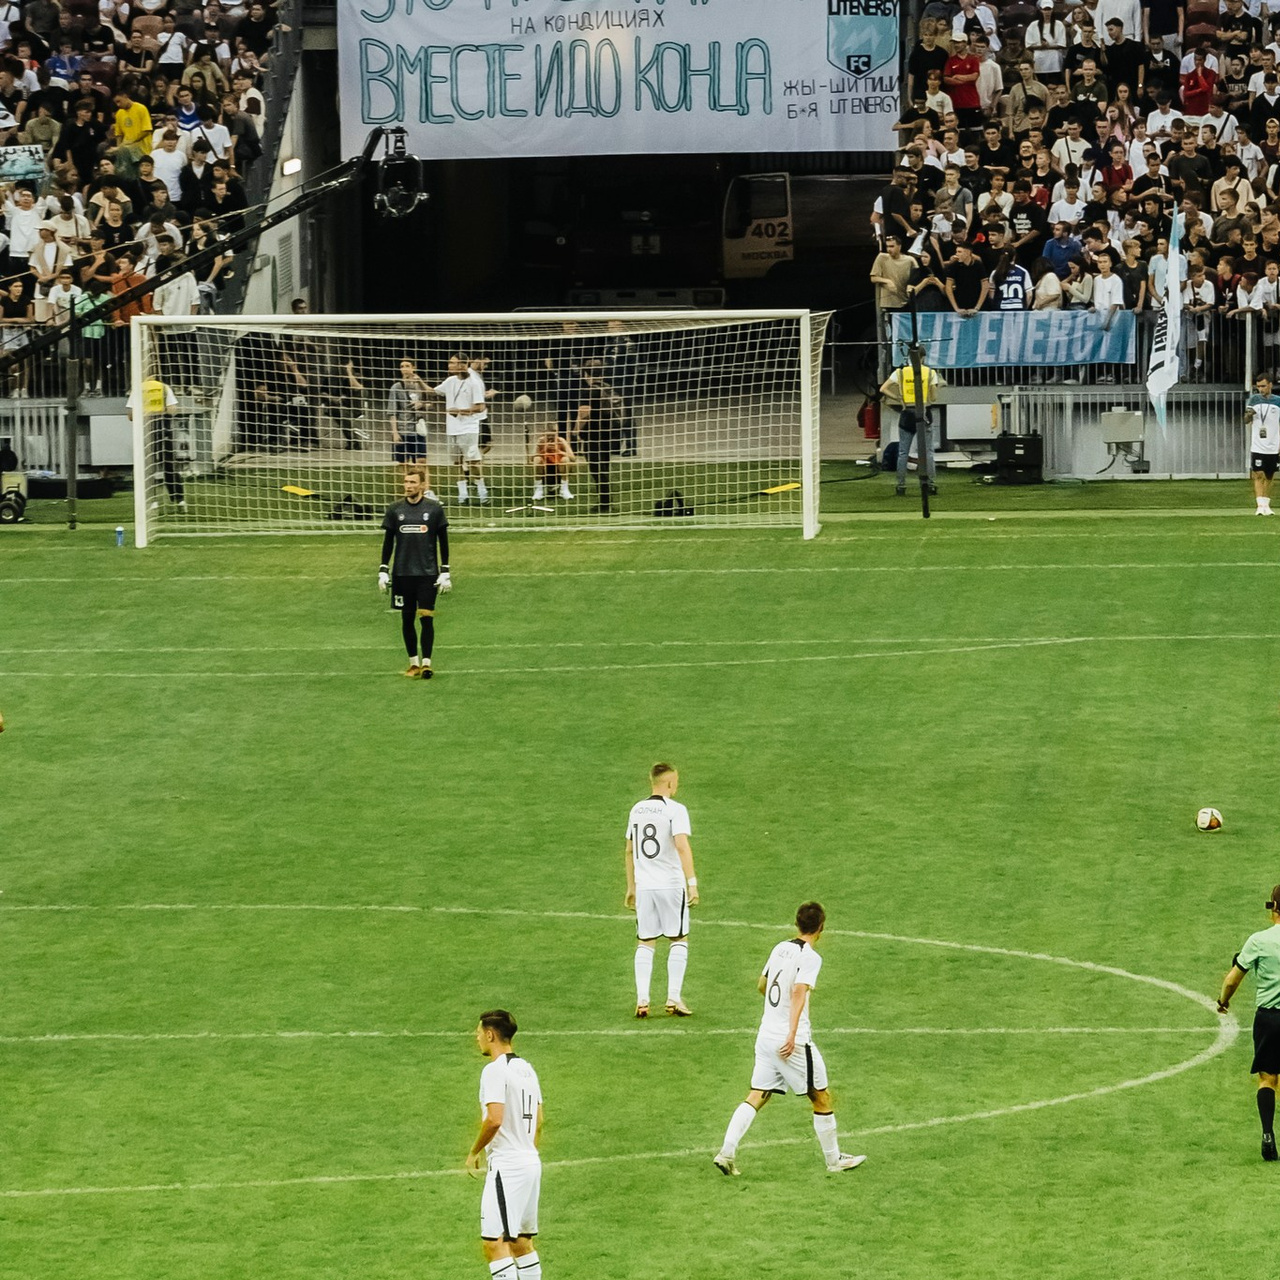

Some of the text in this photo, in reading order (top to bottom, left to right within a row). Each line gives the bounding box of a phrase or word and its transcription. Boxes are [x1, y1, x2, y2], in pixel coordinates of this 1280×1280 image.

[511, 17, 537, 34] НА
[545, 9, 665, 34] КОНДИЦИЯХ
[850, 56, 869, 71] FC
[359, 38, 528, 125] ВМЕСТЕ
[634, 36, 773, 117] КОНЦА
[851, 95, 900, 115] ENERGY
[751, 222, 789, 238] 402
[633, 823, 661, 859] 18
[769, 969, 783, 1007] 6
